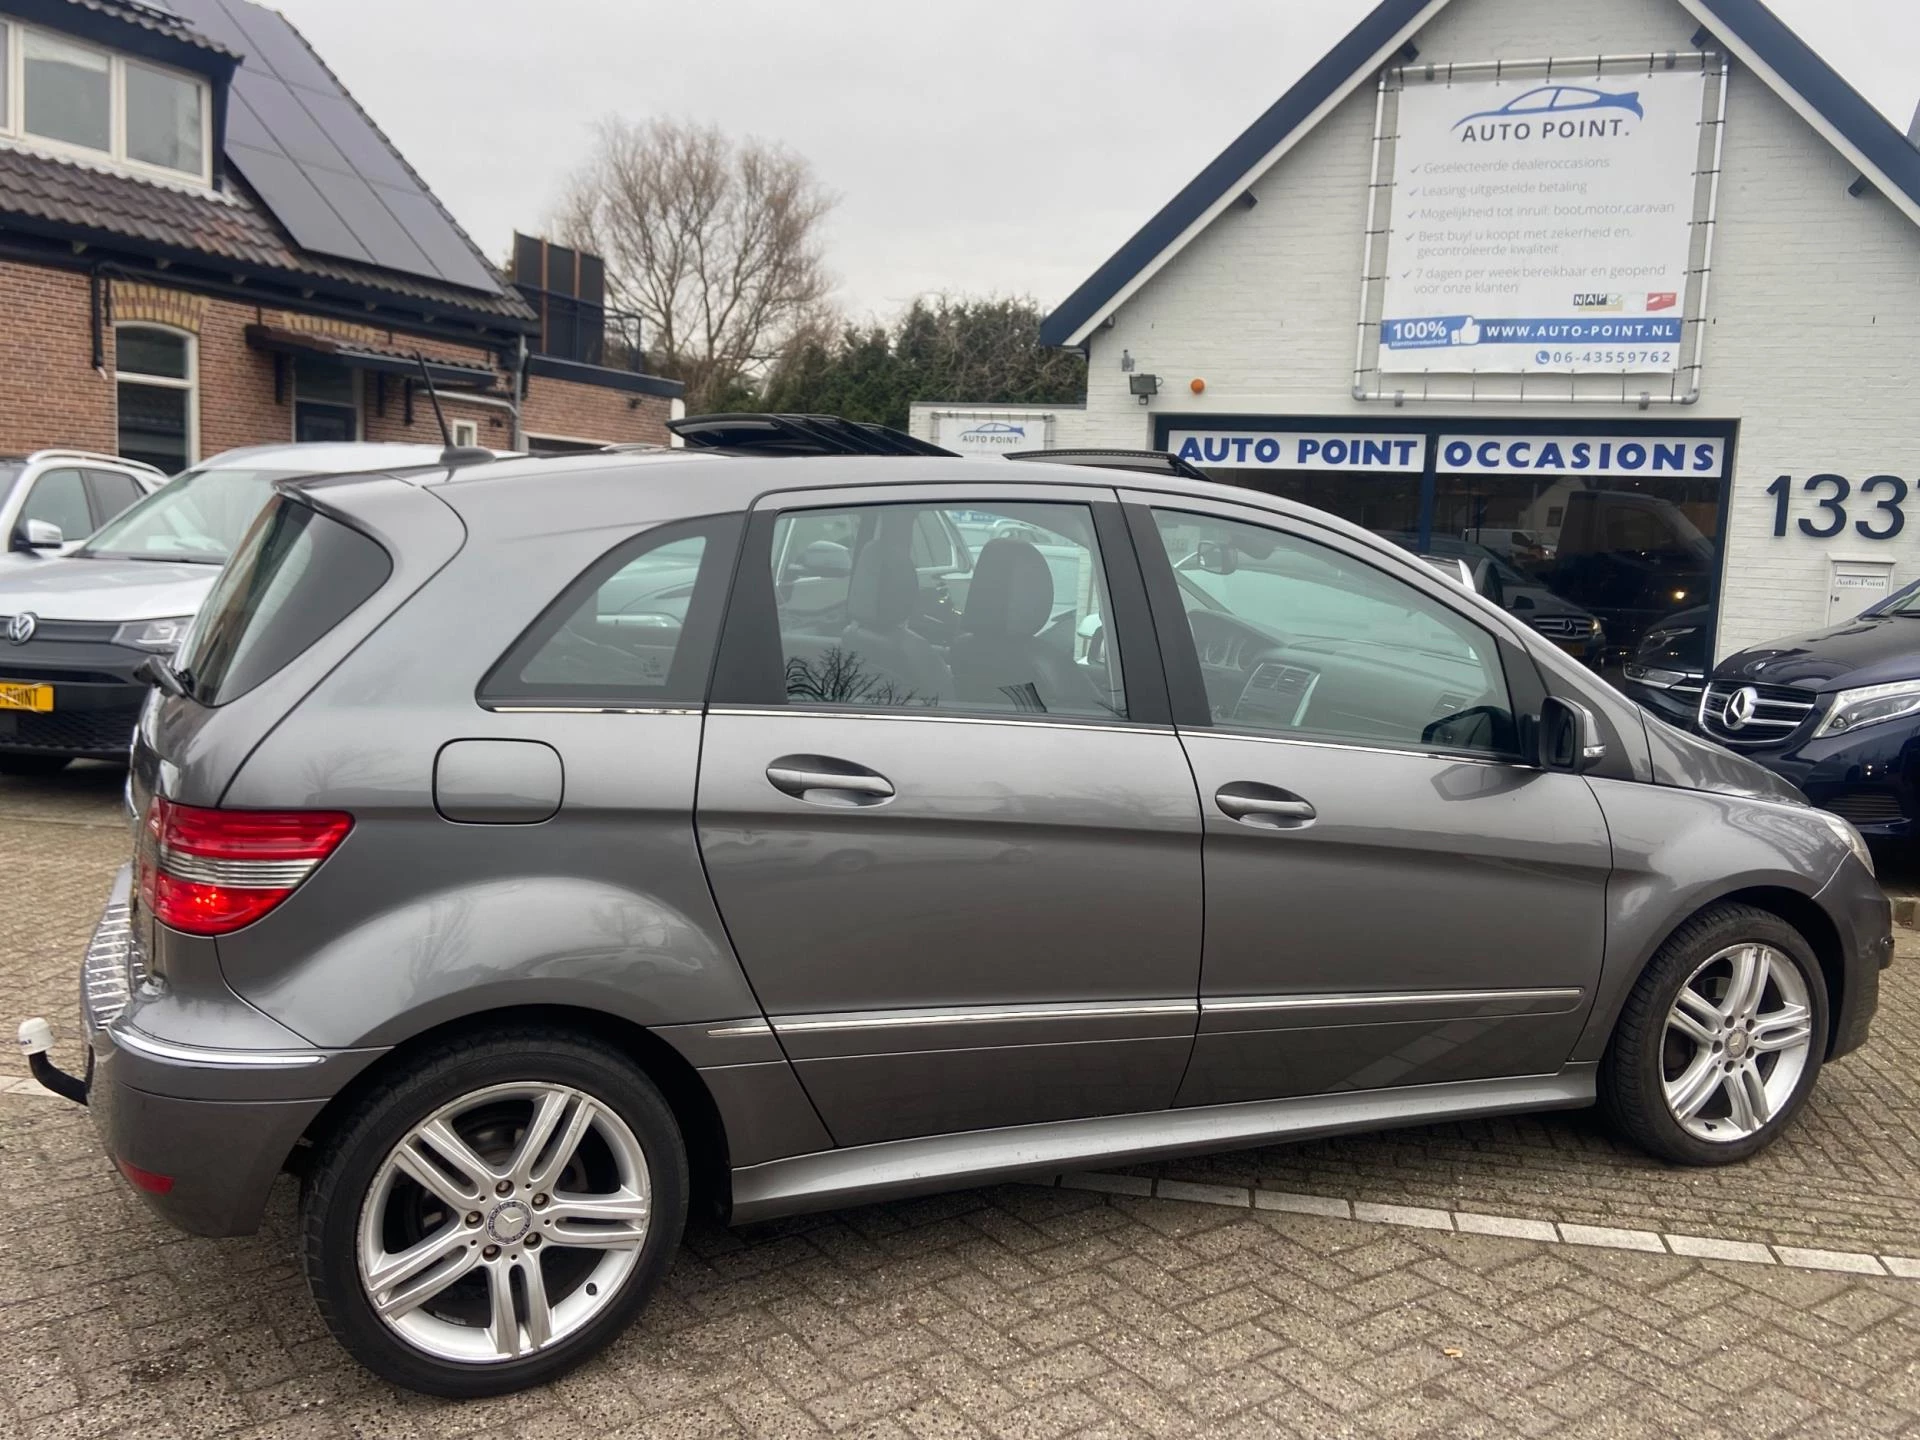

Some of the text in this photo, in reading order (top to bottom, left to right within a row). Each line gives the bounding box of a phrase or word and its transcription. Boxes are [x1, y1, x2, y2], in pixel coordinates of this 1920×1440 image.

[1461, 119, 1630, 142] AUTO POINT.
[1423, 157, 1611, 174] Geselecteerde dealeroccasions
[1538, 181, 1588, 195] betaling
[1420, 206, 1494, 222] Mogelijkheid
[1497, 207, 1513, 217] tot
[1418, 230, 1444, 242] Best
[1475, 232, 1483, 241] u
[1486, 228, 1521, 243] koopt
[1524, 228, 1548, 239] met
[1550, 226, 1612, 239] zekerheid
[1416, 243, 1559, 259] gecontroleerde kwaliteit
[1415, 264, 1666, 281] 7 dagen per week bereikbaar en geopend
[1414, 282, 1519, 294] voor onze klanten
[1393, 320, 1673, 339] 100% WWW.AUTO-POINT.NL
[1553, 351, 1671, 364] 06-43559762
[962, 435, 987, 443] AUTO
[1177, 436, 1715, 472] AUTO POINT OCCASIONS
[1766, 473, 1920, 540] 133
